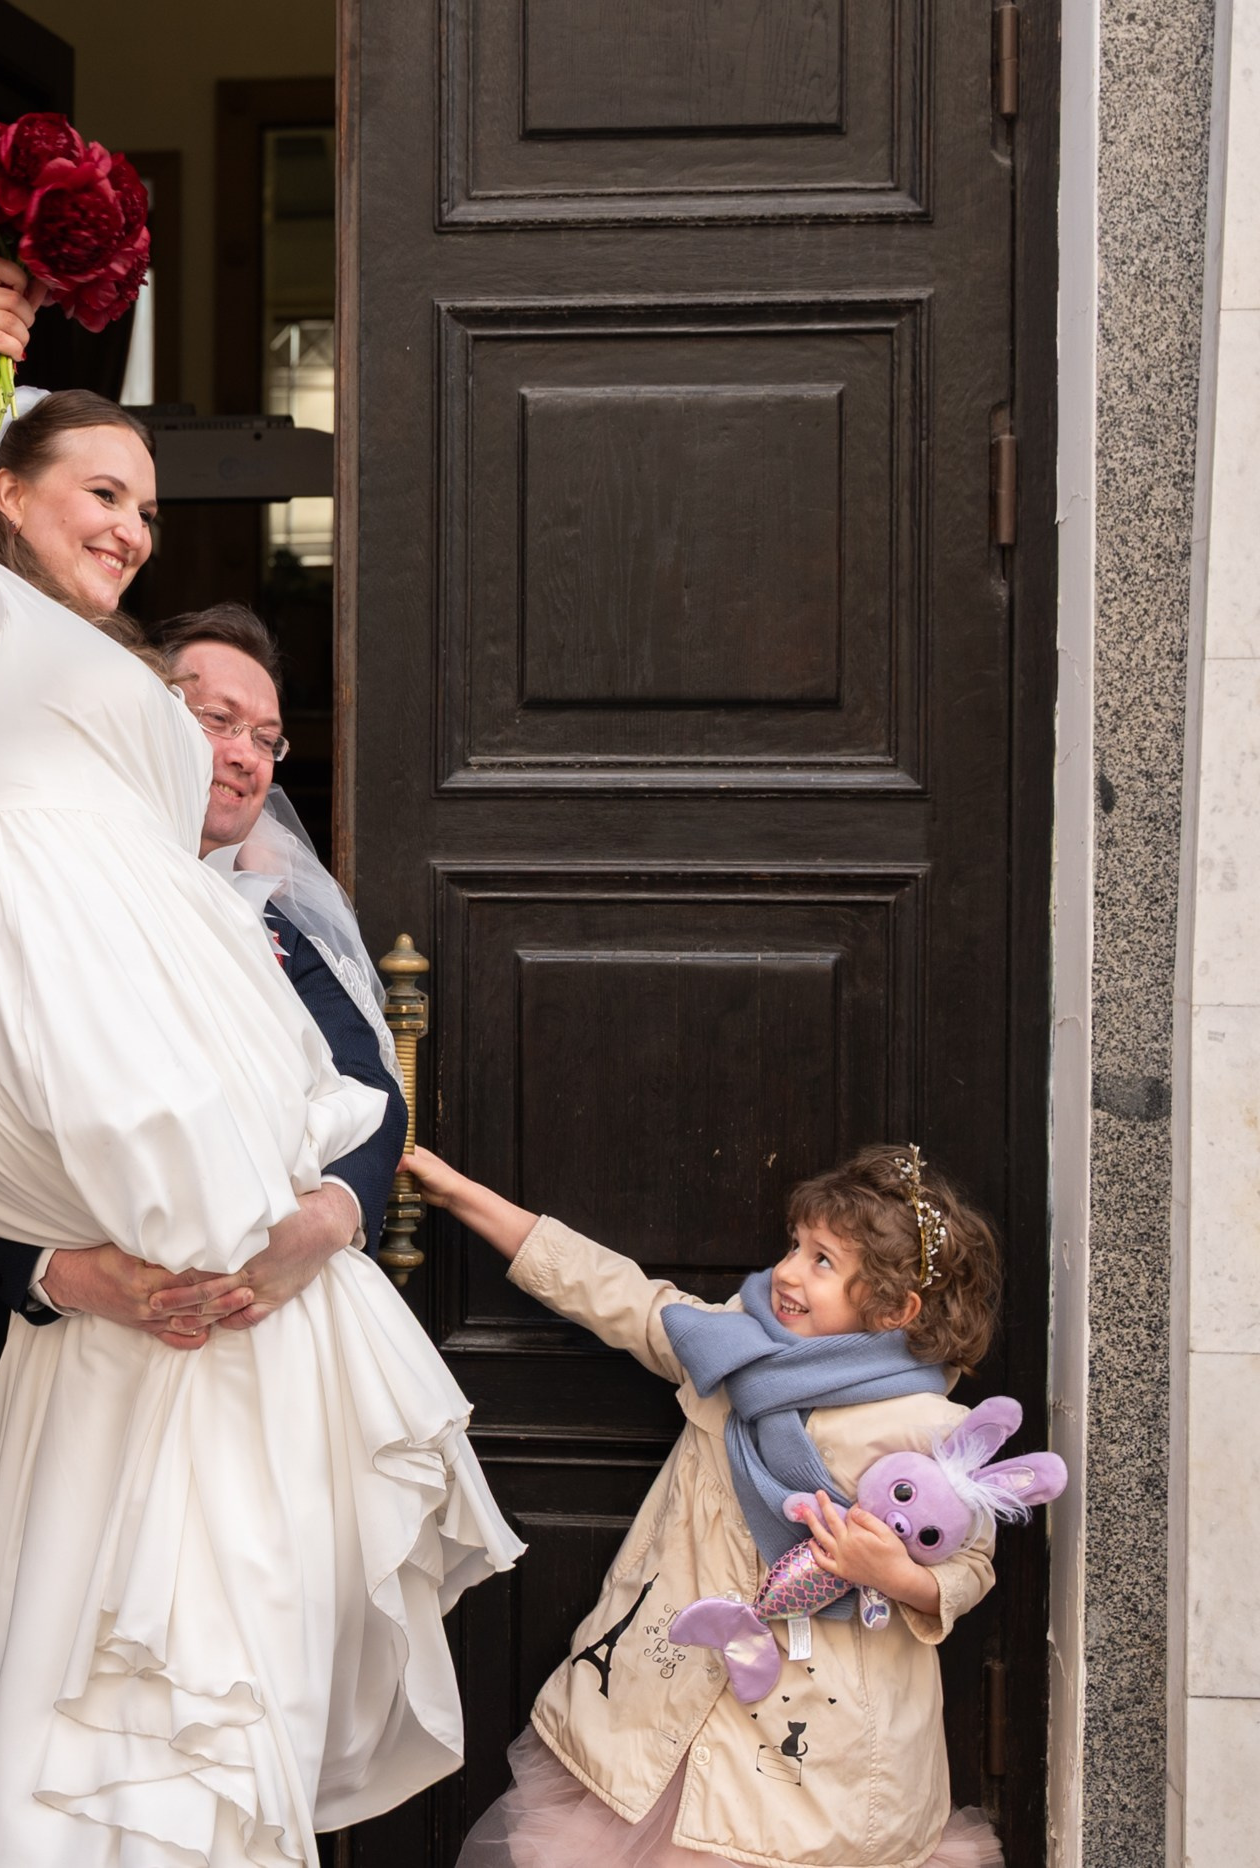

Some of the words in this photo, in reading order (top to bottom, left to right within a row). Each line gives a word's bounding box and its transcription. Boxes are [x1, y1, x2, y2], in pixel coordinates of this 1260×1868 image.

[643, 1625, 660, 1635] me
[673, 1647, 686, 1661] to
[644, 1638, 676, 1679] Paris
